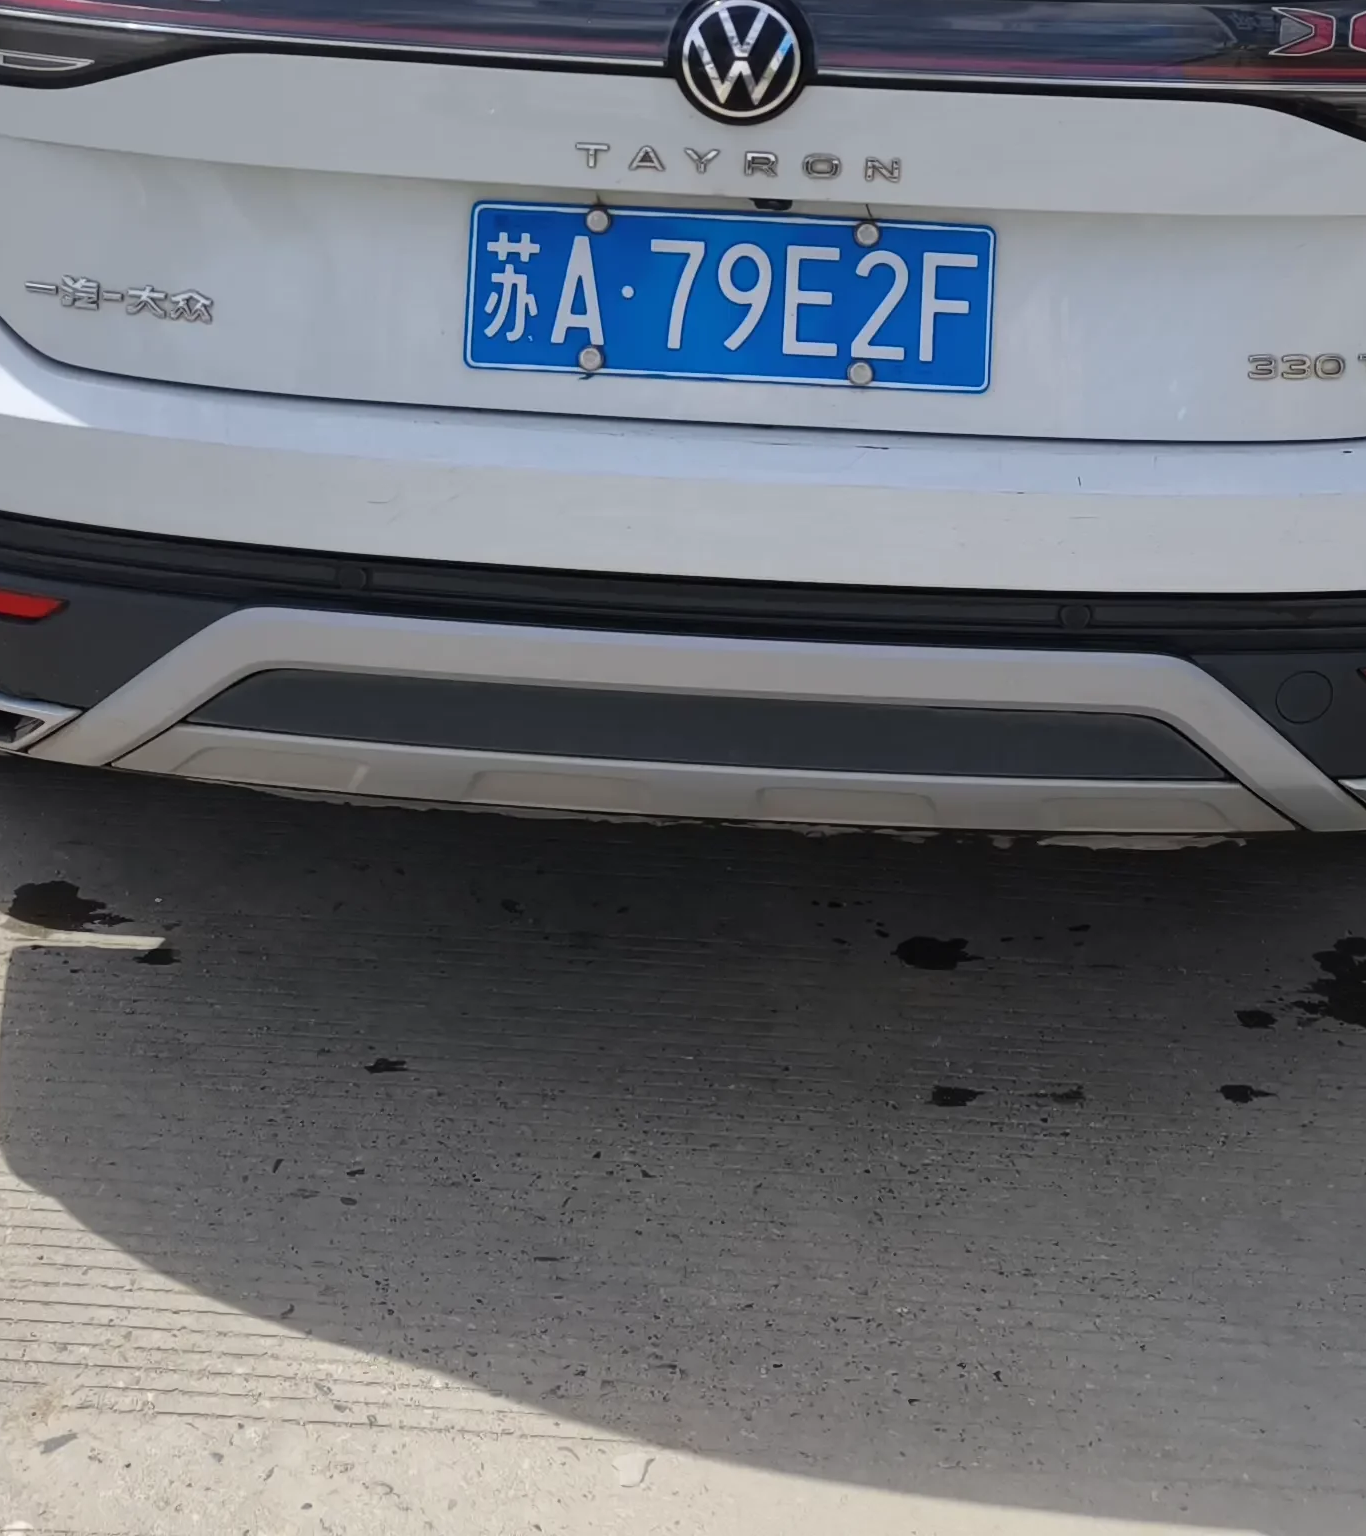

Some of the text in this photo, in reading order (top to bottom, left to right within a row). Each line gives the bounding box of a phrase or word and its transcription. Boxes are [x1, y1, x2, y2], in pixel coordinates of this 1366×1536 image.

[575, 141, 902, 184] TAYRON
[483, 231, 979, 363] 苏A·79E2F
[1247, 352, 1347, 380] 330
